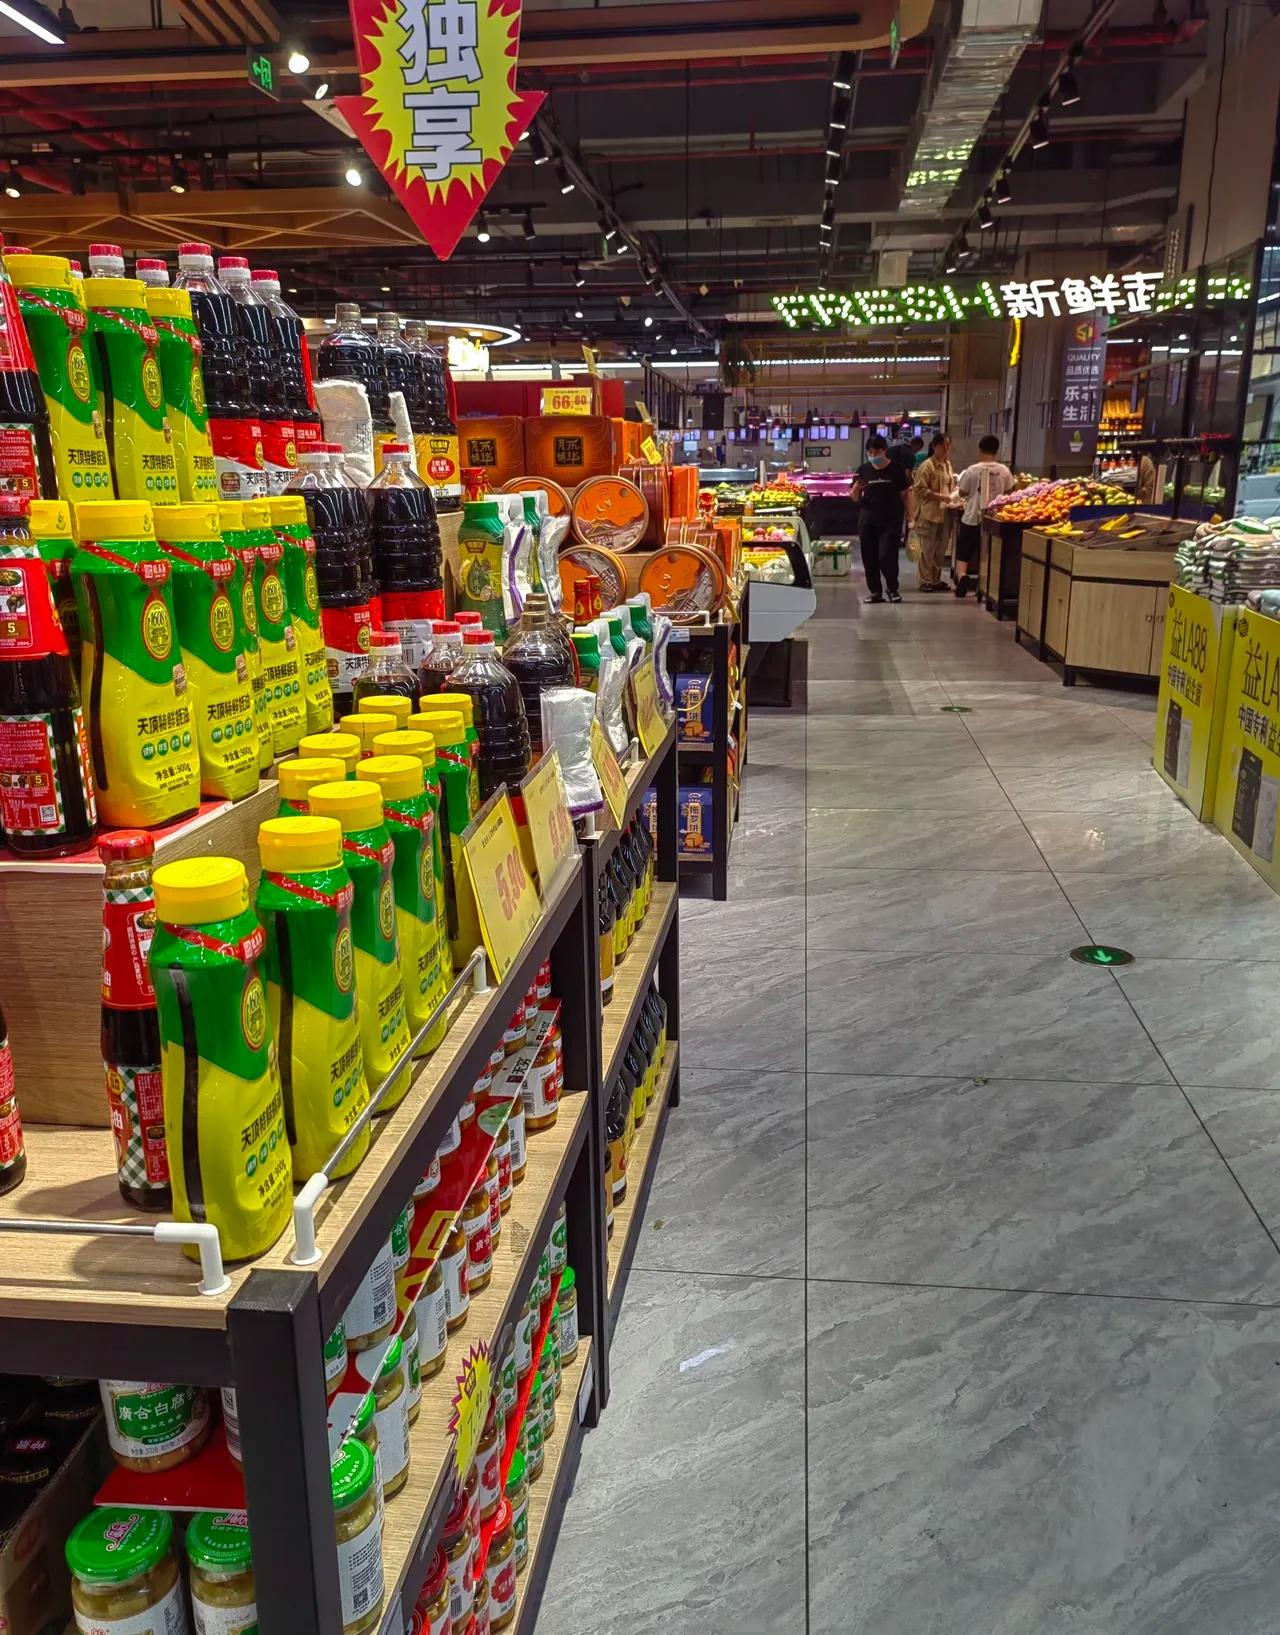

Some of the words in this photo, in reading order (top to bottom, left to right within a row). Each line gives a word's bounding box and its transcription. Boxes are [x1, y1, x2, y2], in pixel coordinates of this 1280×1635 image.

[397, 0, 483, 181] 独享
[771, 280, 1001, 328] FRESH
[1067, 353, 1100, 361] QUALITY
[7, 622, 16, 633] 5
